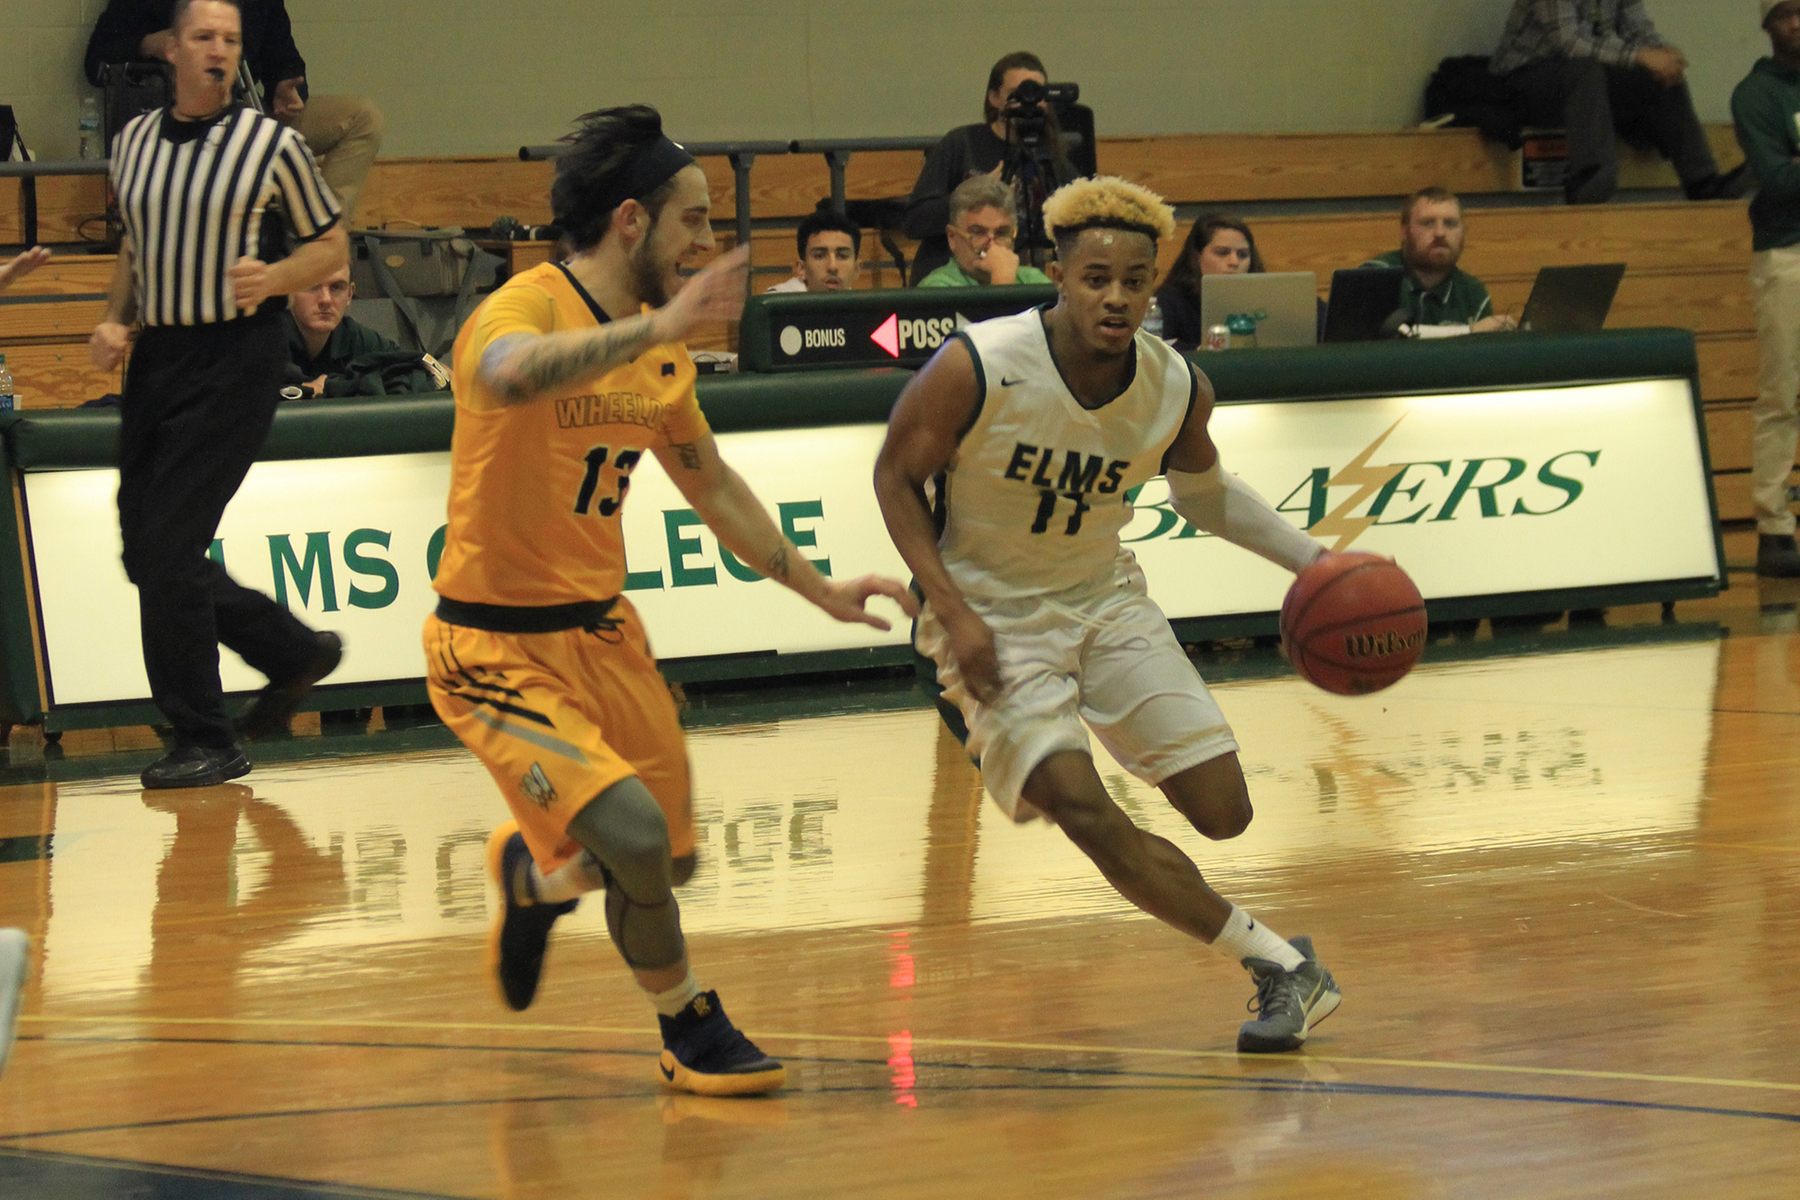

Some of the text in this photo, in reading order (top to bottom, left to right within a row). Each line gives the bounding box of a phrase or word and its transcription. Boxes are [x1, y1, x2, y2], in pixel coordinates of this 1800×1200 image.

[805, 328, 846, 348] BONUS
[898, 317, 954, 349] POSS
[574, 446, 640, 517] 13
[1004, 442, 1131, 494] ELMS
